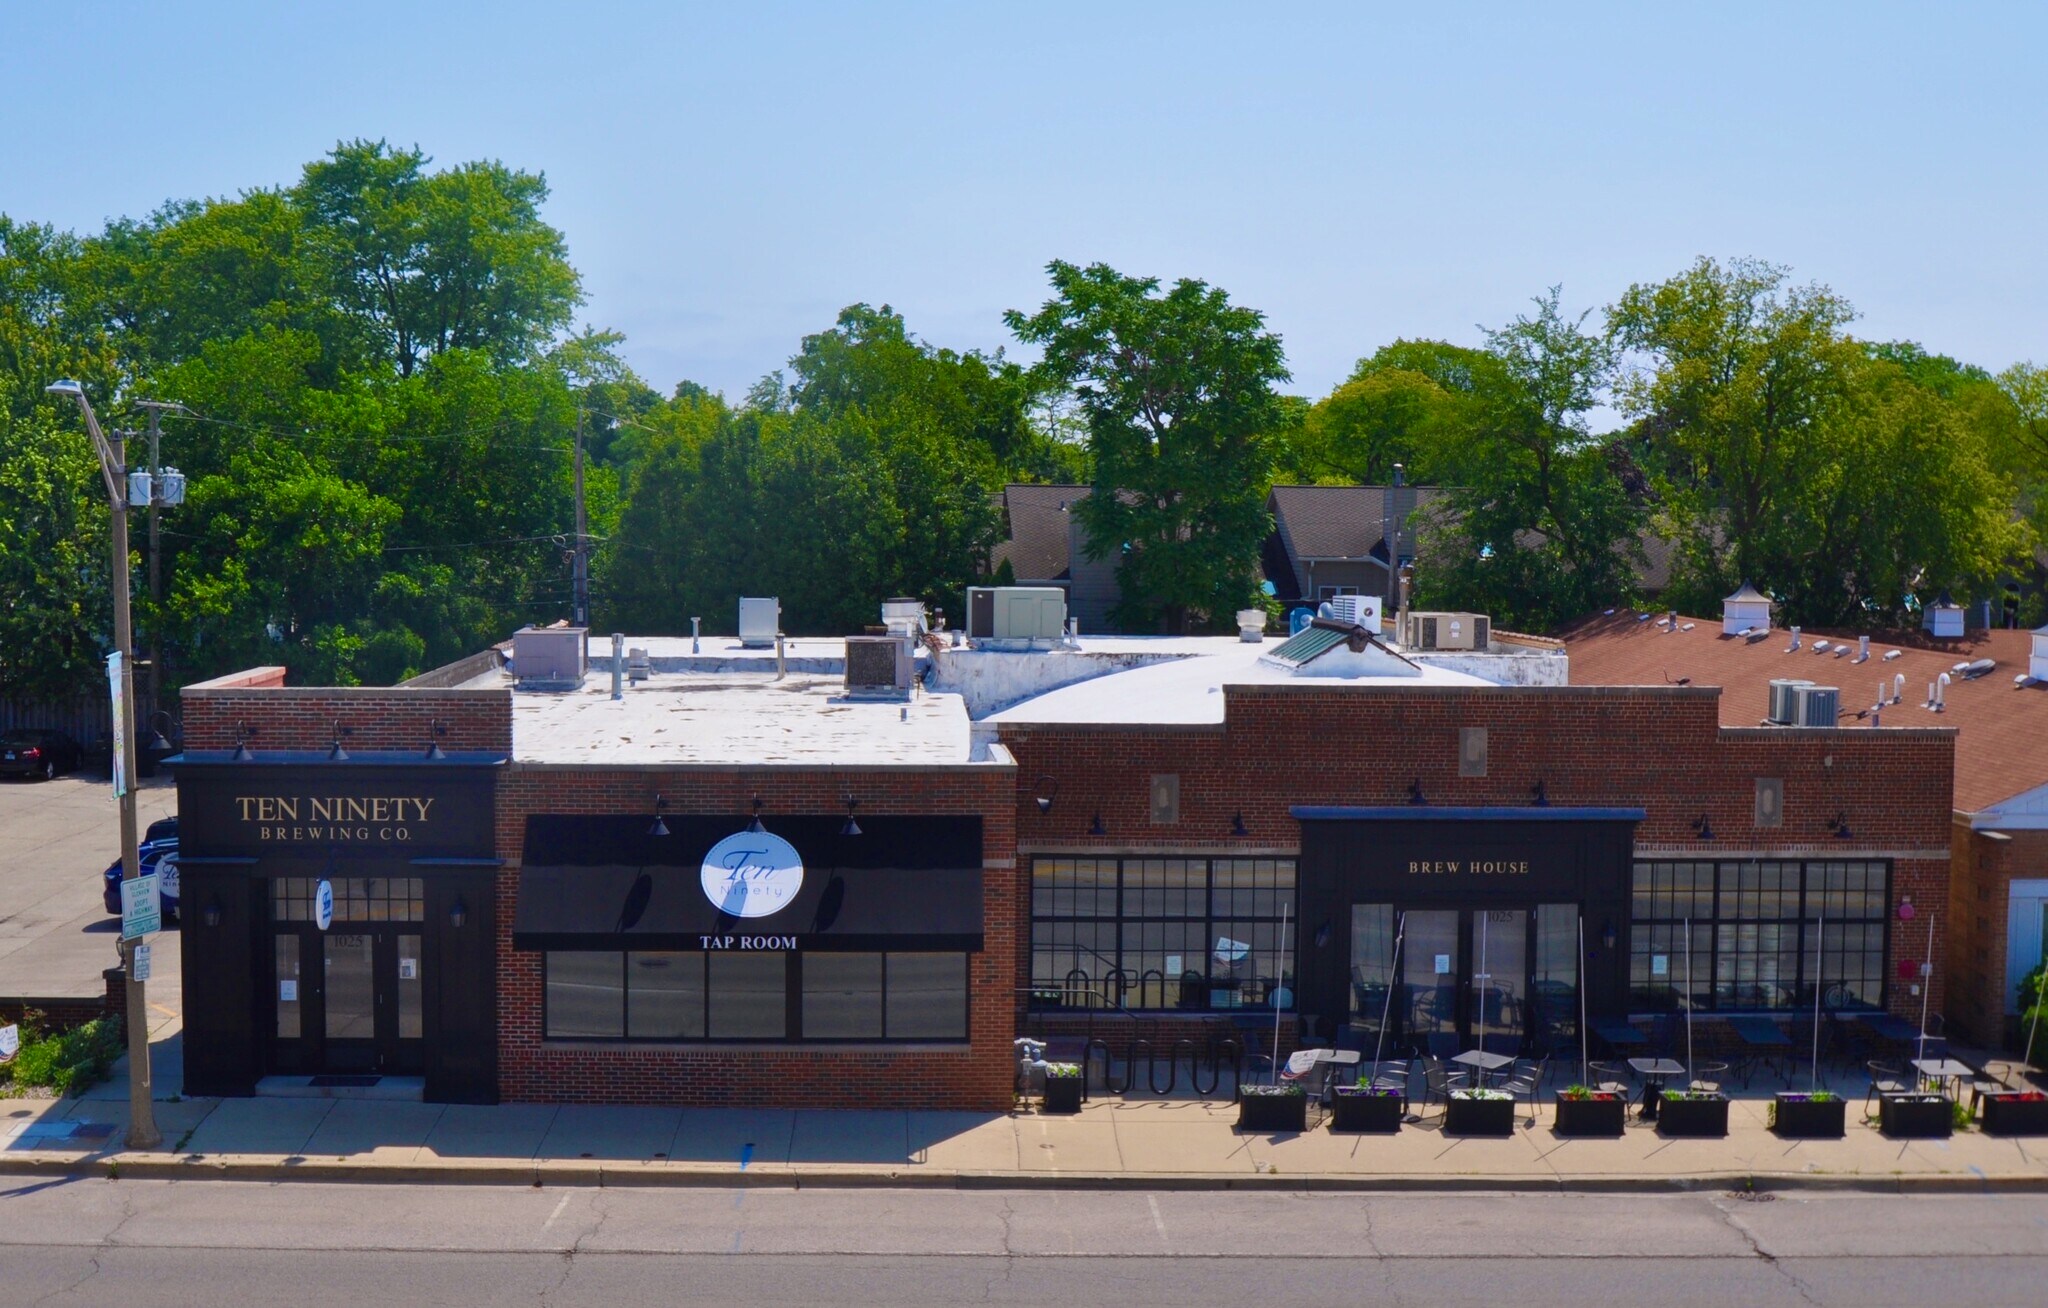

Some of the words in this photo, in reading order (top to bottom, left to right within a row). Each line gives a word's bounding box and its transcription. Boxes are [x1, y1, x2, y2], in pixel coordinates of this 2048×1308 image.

[235, 797, 299, 821] TEN
[309, 797, 435, 822] NINETY
[260, 827, 369, 841] BREWING
[380, 827, 412, 841] CO.
[722, 848, 776, 880] Ten
[1409, 862, 1460, 874] BREW
[1470, 862, 1529, 874] HOUSE
[162, 863, 179, 880] Te
[720, 885, 783, 897] Ninety
[1488, 911, 1513, 923] 1025
[334, 935, 363, 948] 1025
[699, 936, 735, 949] TAP
[740, 936, 797, 949] ROOM
